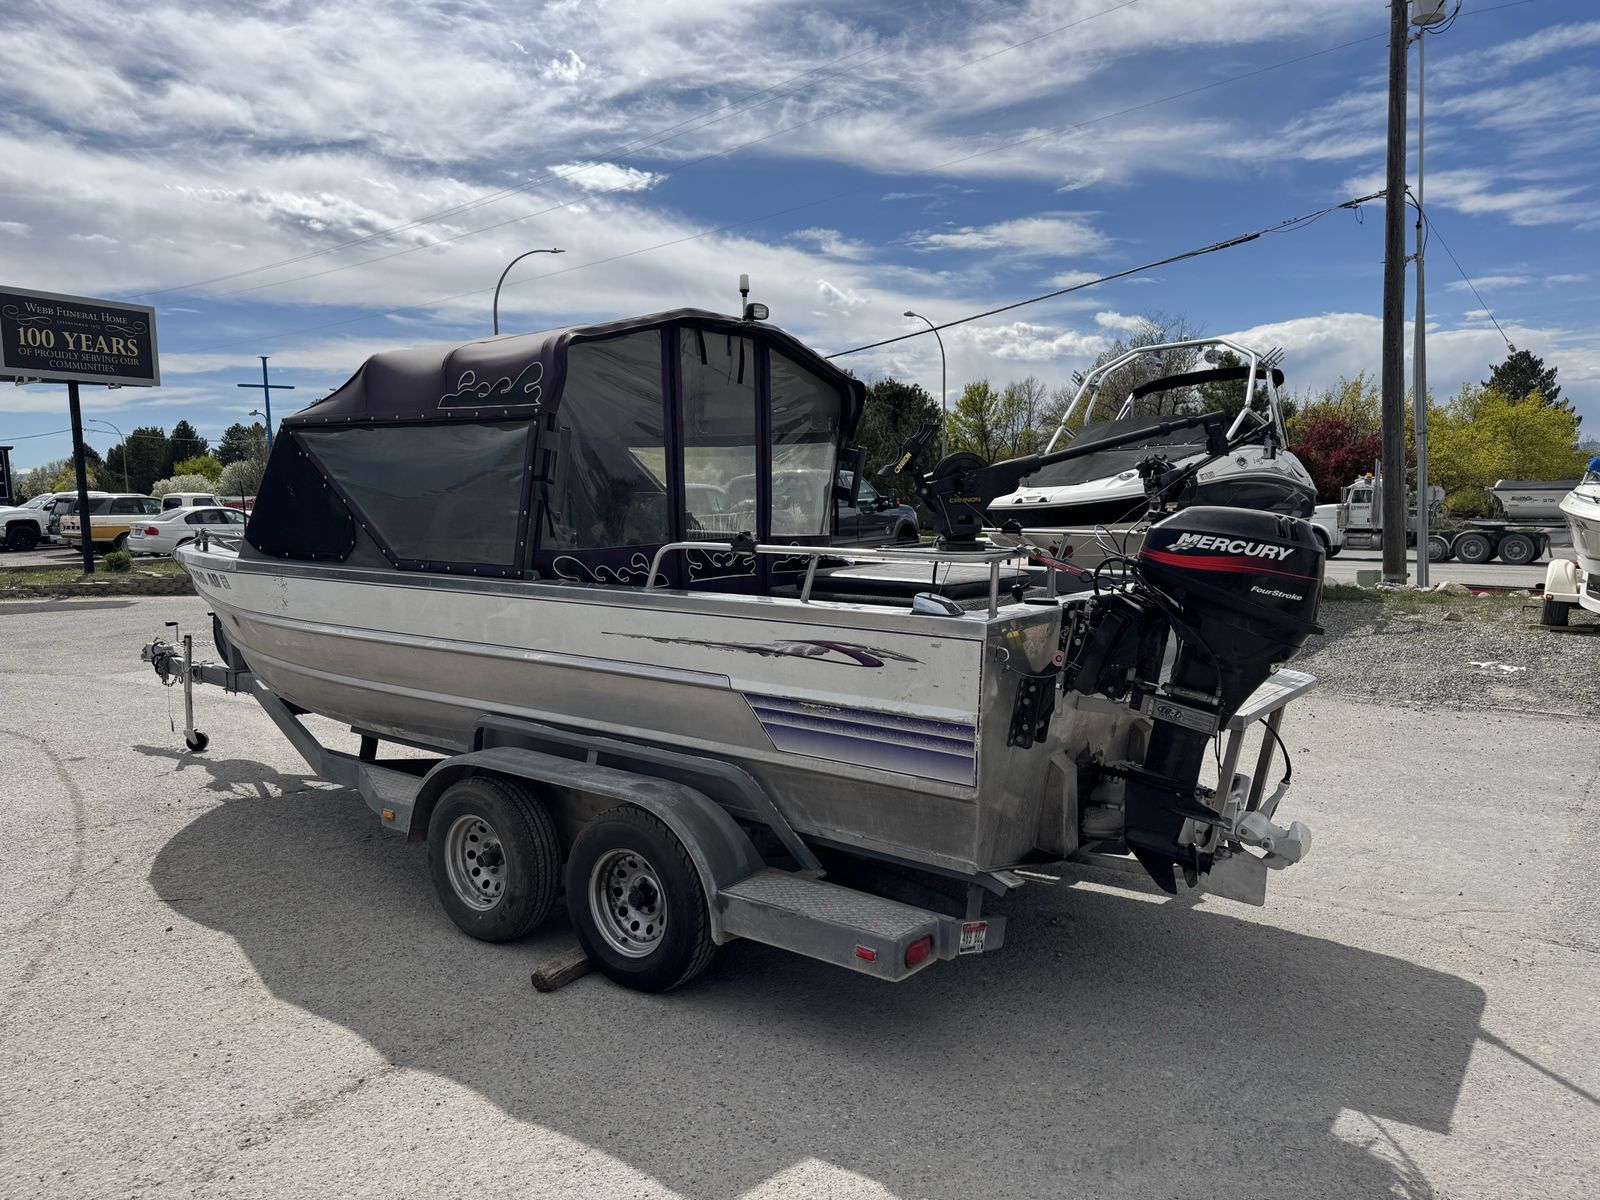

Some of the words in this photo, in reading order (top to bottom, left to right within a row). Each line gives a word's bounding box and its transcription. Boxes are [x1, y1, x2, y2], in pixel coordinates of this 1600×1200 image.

[17, 326, 55, 348] 100
[62, 331, 138, 357] YEARS
[18, 347, 32, 356] OF
[34, 348, 79, 361] PROUDLY
[81, 351, 119, 365] SERVING
[120, 356, 140, 366] OUR
[49, 359, 115, 373] COMMUNITIES
[1175, 532, 1295, 561] MERCURY
[1250, 585, 1303, 601] FourStroke
